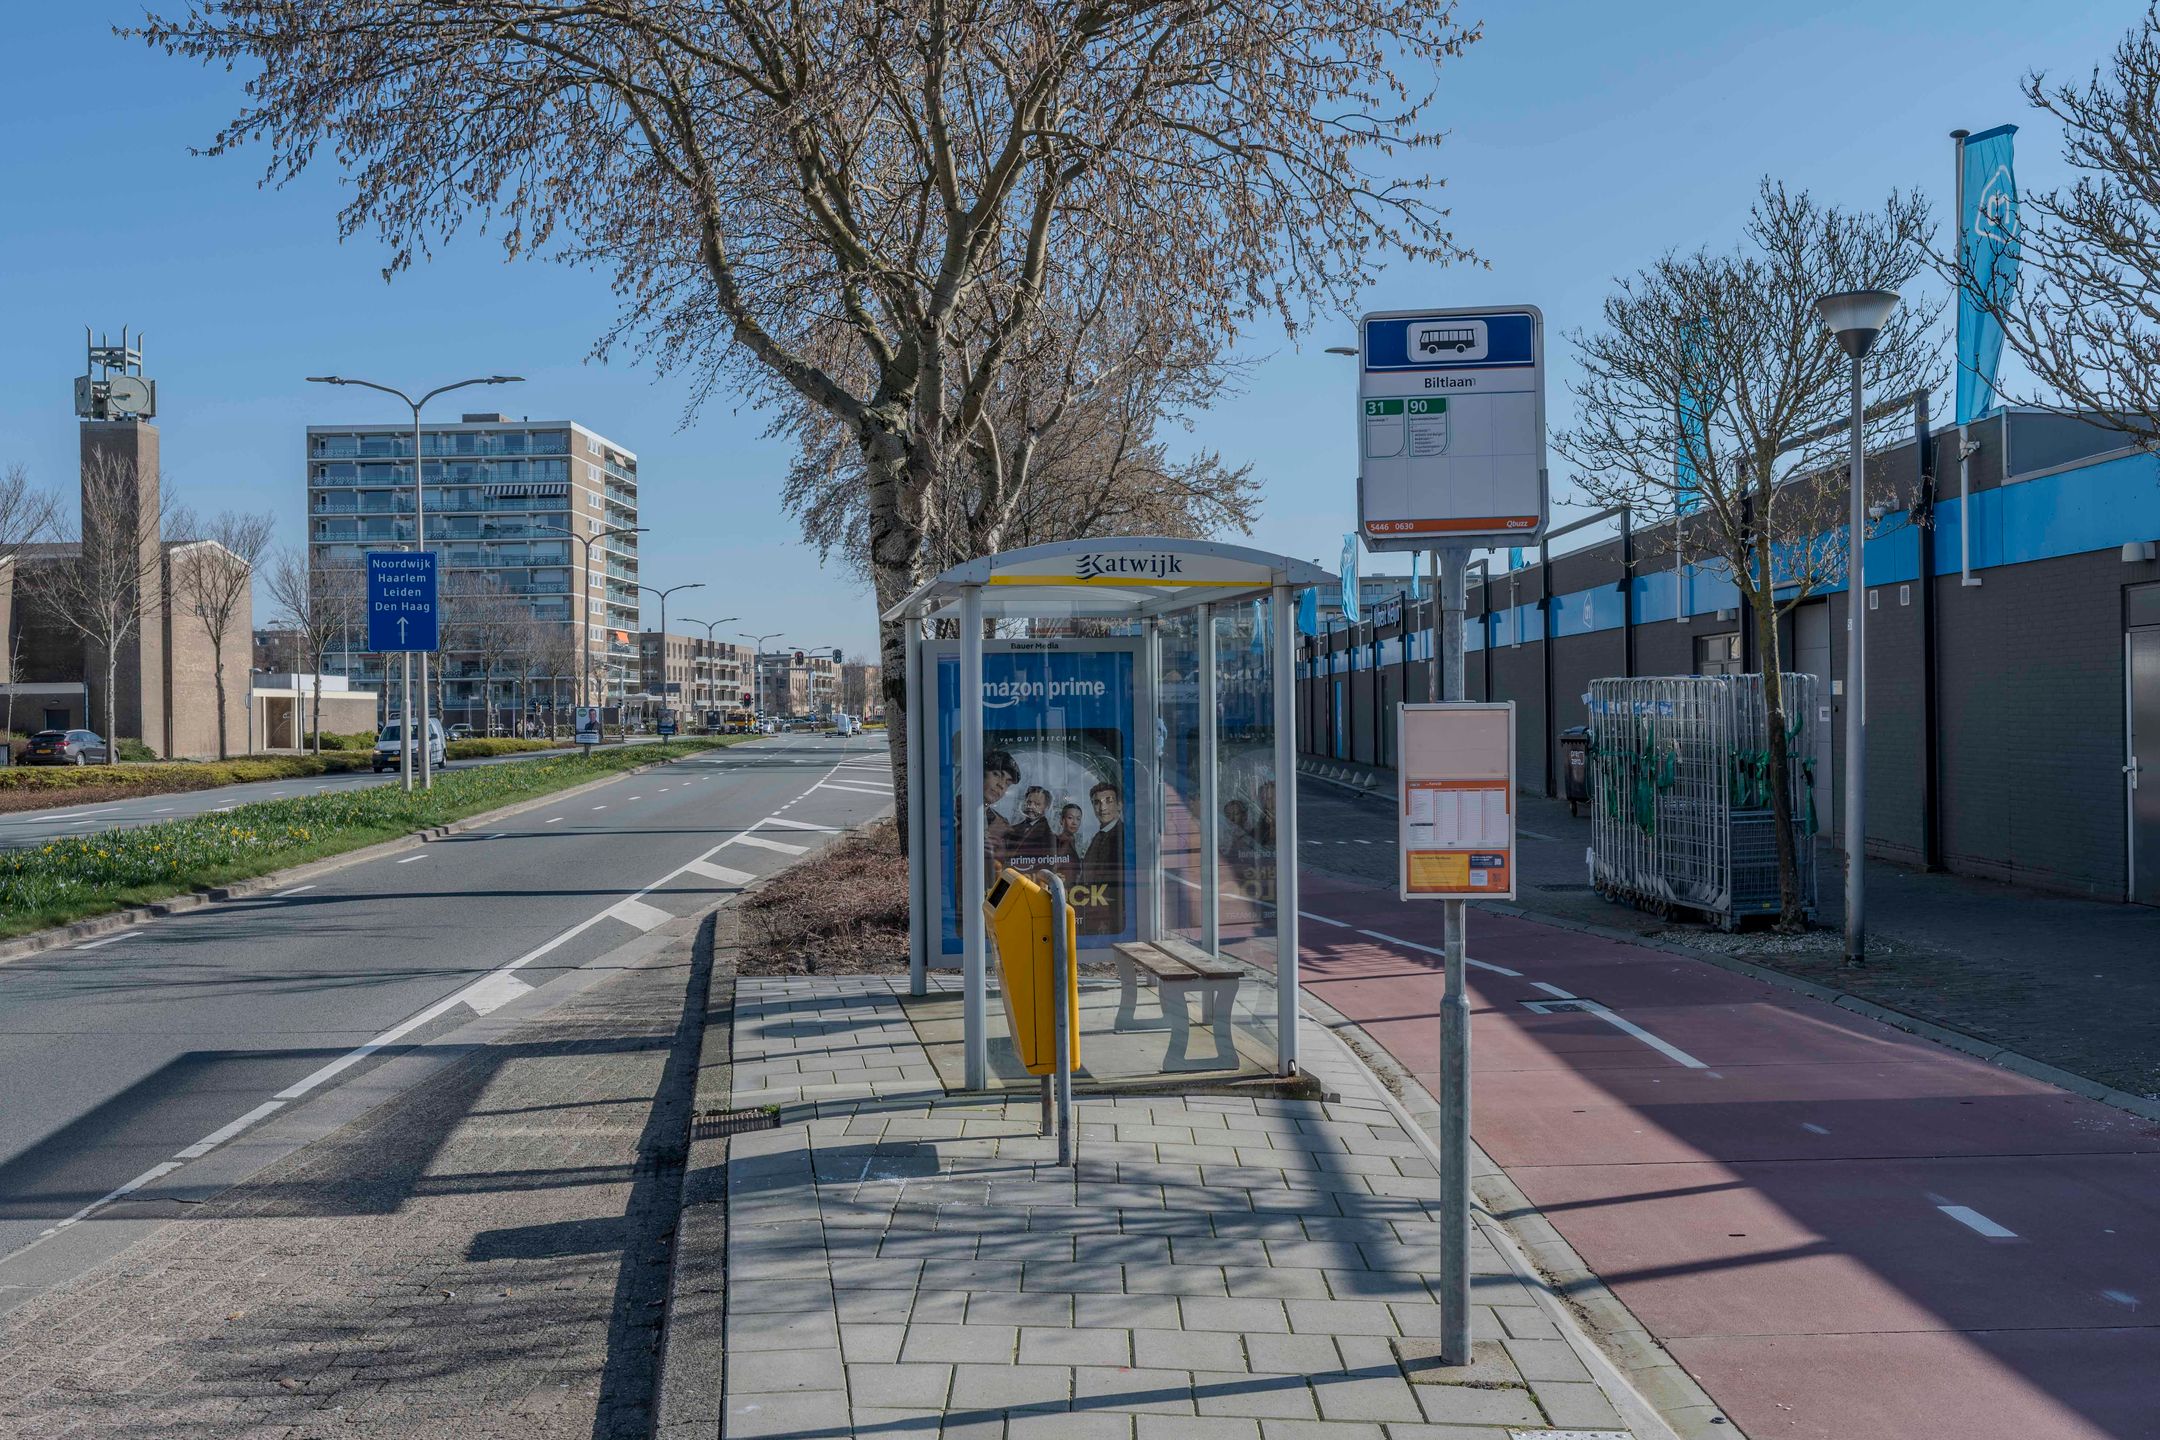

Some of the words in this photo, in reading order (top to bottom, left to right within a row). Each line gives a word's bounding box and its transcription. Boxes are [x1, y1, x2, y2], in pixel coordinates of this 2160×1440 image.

[1424, 377, 1473, 389] Biltlaan
[1367, 401, 1384, 415] 31
[1410, 400, 1428, 413] 90
[1370, 523, 1389, 531] 5446
[1395, 522, 1414, 530] 0630
[1506, 520, 1529, 528] Qbuzz
[372, 559, 431, 571] Noordwijk
[1076, 554, 1182, 579] Katwijk
[378, 573, 426, 583] Haarlem
[383, 587, 421, 597] Leiden
[375, 601, 397, 611] Den
[401, 601, 430, 613] Haag
[1010, 642, 1034, 650] Bauer
[1035, 642, 1059, 650] Media
[982, 679, 1044, 697] mazon
[1049, 677, 1106, 699] prime
[1010, 855, 1036, 866] prime
[1037, 854, 1070, 865] original
